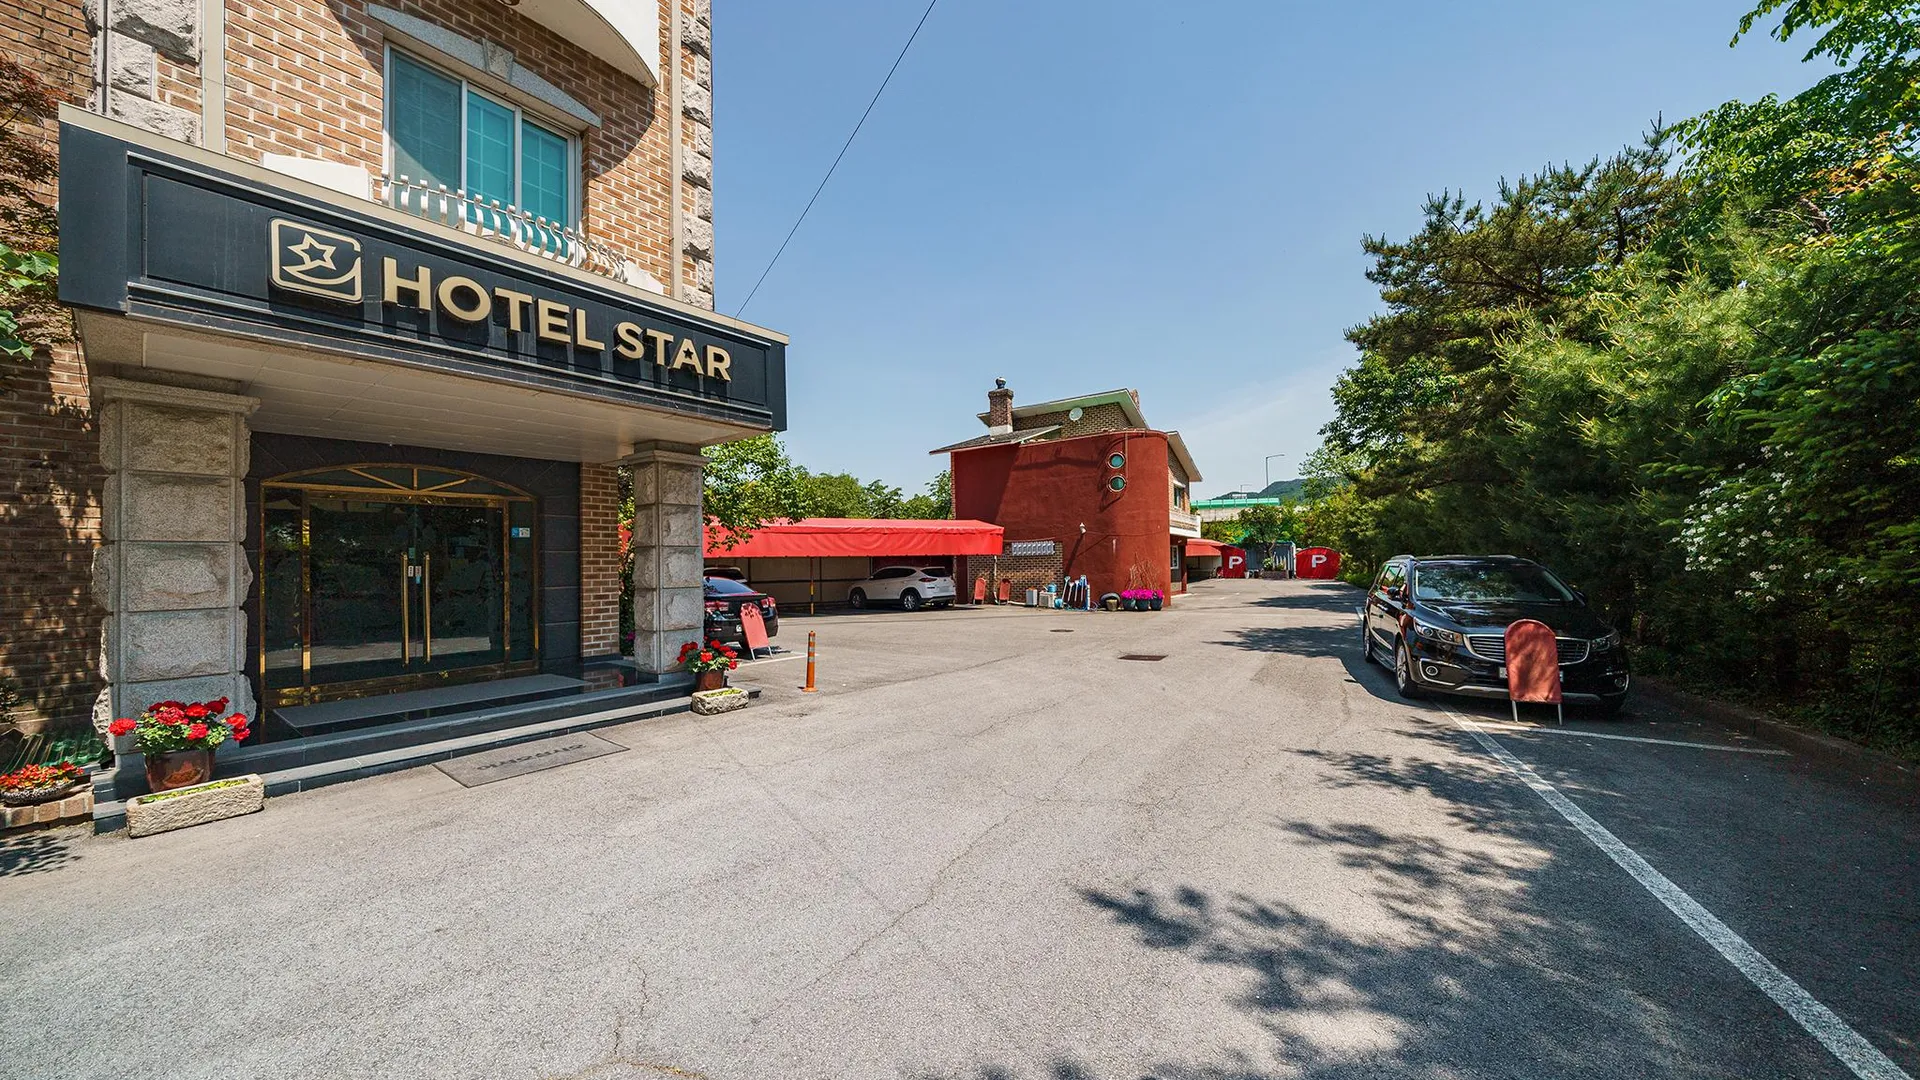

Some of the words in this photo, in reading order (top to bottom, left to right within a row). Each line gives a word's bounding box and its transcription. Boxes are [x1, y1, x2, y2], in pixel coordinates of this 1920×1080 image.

[382, 256, 605, 351] HOTEL
[614, 320, 732, 382] STAR
[1228, 555, 1243, 569] P
[1311, 554, 1327, 568] P
